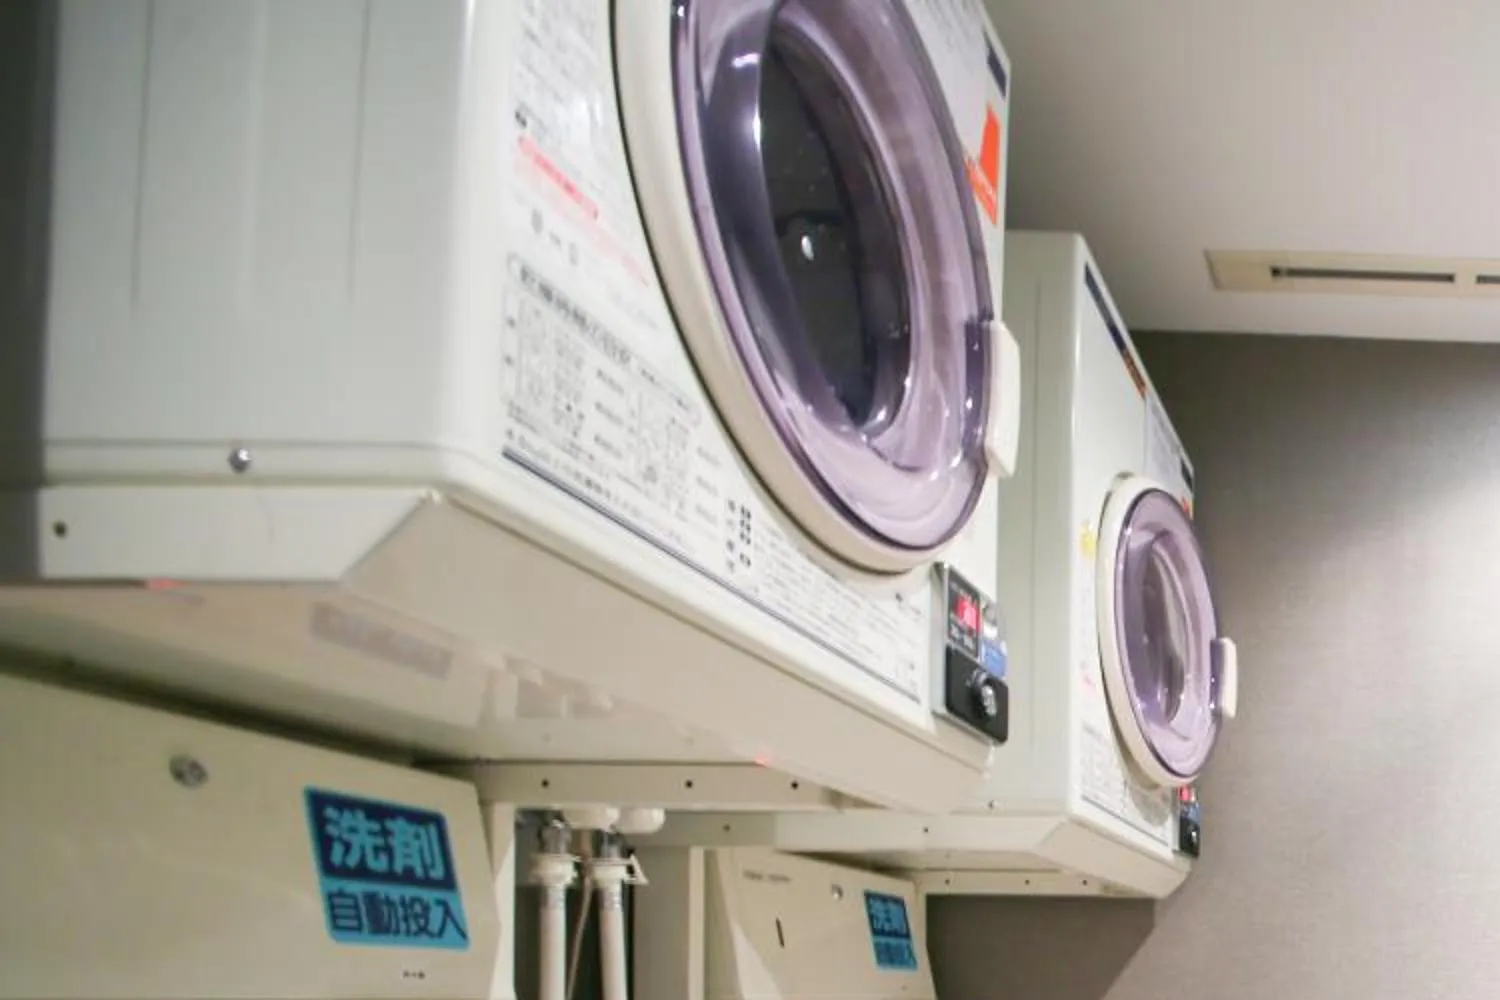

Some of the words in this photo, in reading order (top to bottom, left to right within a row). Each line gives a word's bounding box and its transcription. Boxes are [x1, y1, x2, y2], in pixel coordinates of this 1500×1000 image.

[323, 805, 446, 880] 洗剤
[327, 887, 468, 940] 自動投入
